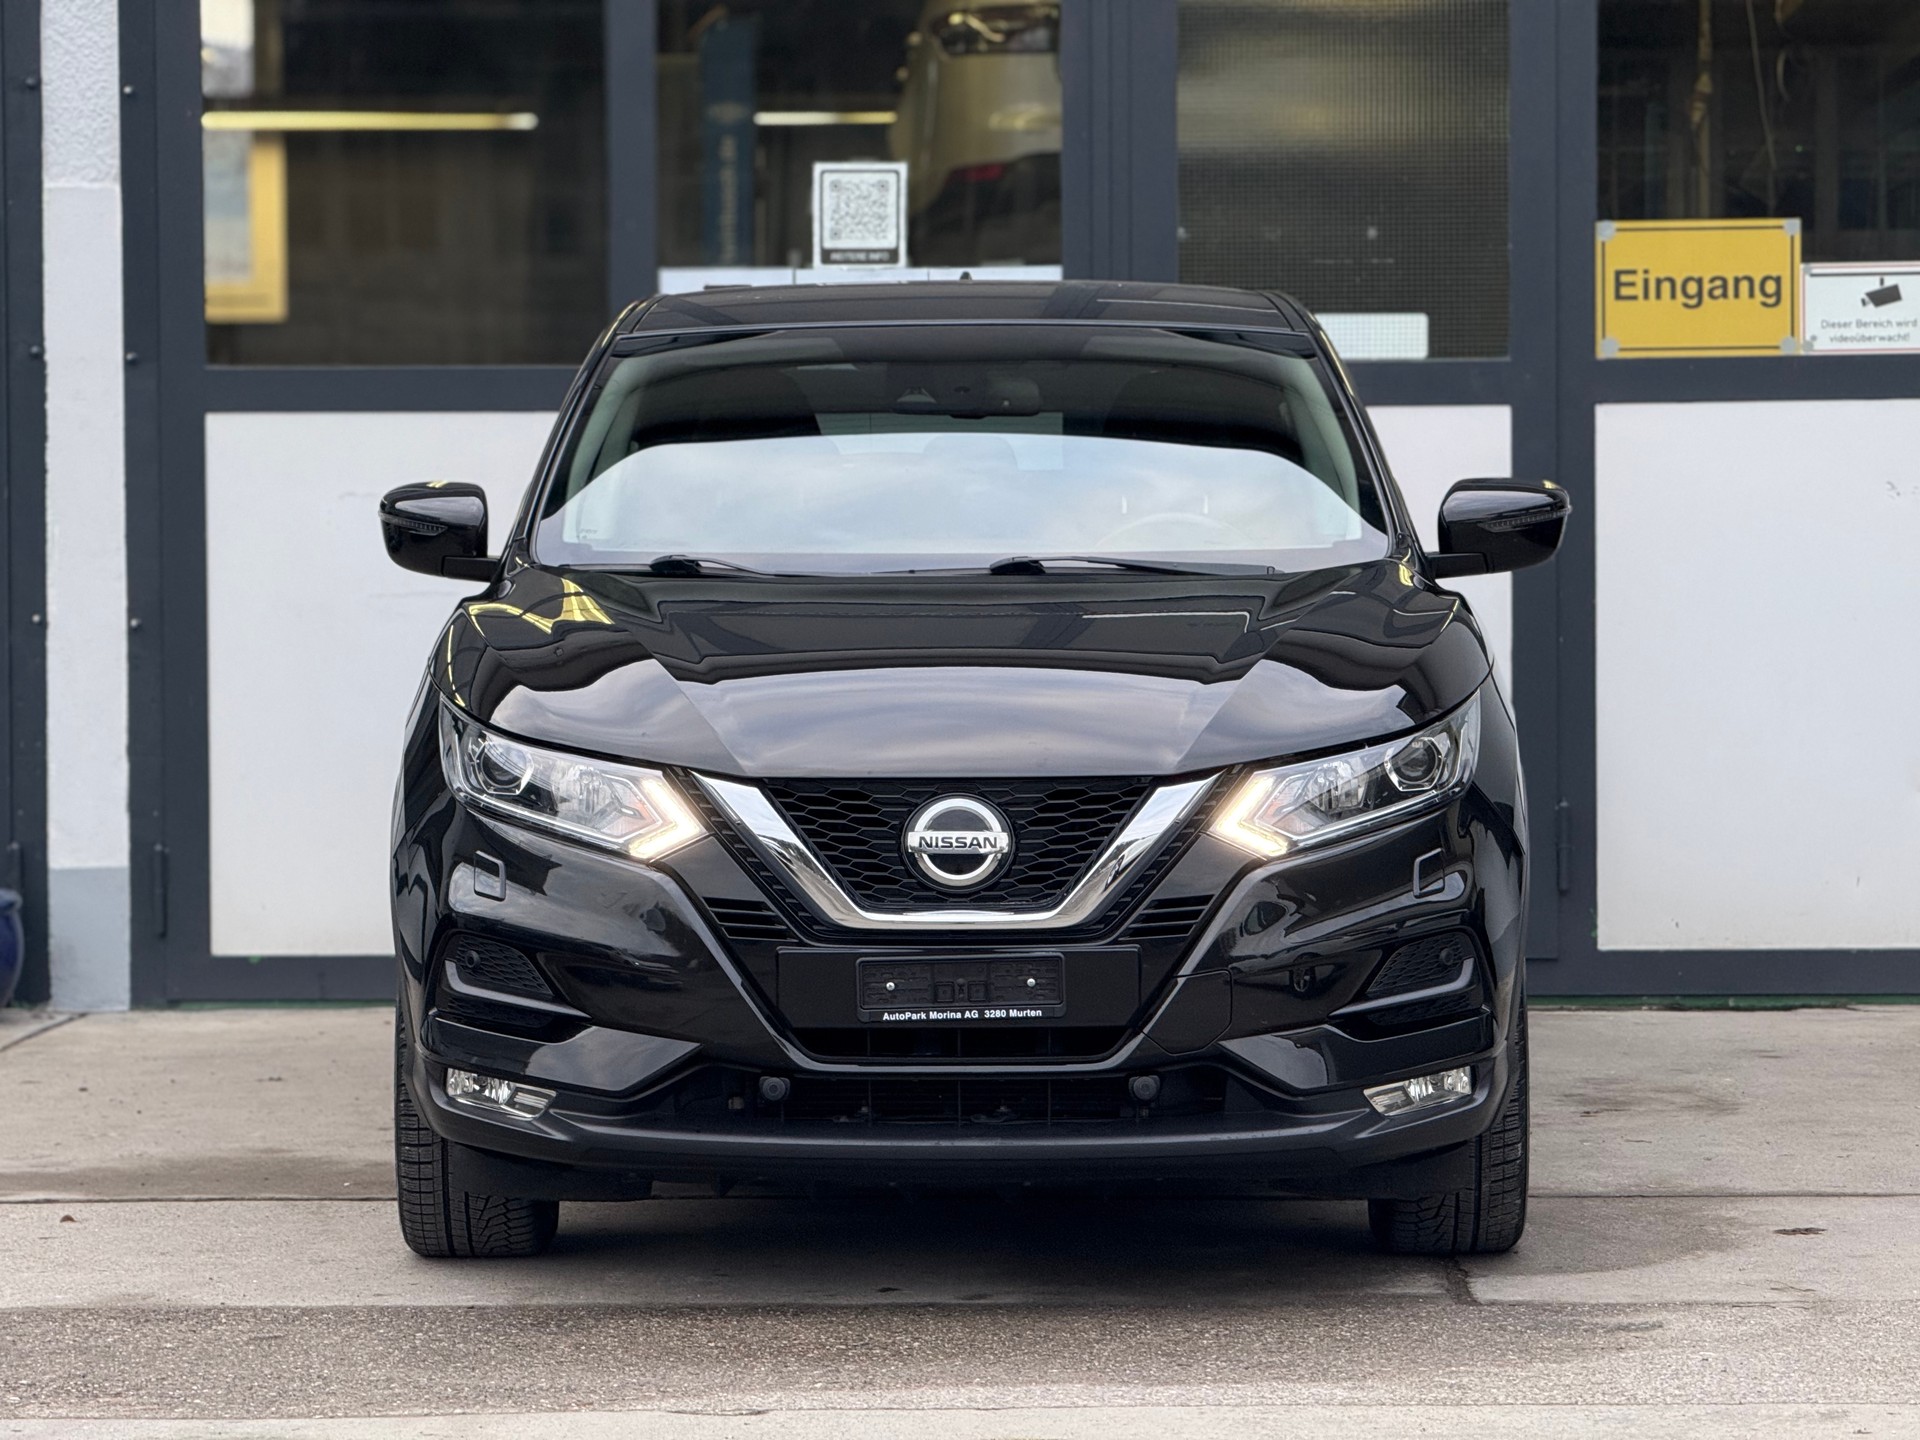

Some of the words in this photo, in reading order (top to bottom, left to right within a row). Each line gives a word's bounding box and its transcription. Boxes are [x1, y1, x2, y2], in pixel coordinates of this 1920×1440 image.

[1614, 269, 1782, 309] Eingang
[1821, 319, 1853, 329] Dieser
[1855, 318, 1893, 329] Bereich
[1895, 318, 1918, 328] wird
[919, 836, 998, 849] NISSAN
[882, 1011, 927, 1021] AutoPark
[929, 1010, 962, 1019] Morina
[963, 1010, 979, 1019] AG
[984, 1009, 1007, 1018] 3280
[1009, 1008, 1042, 1017] Murten
